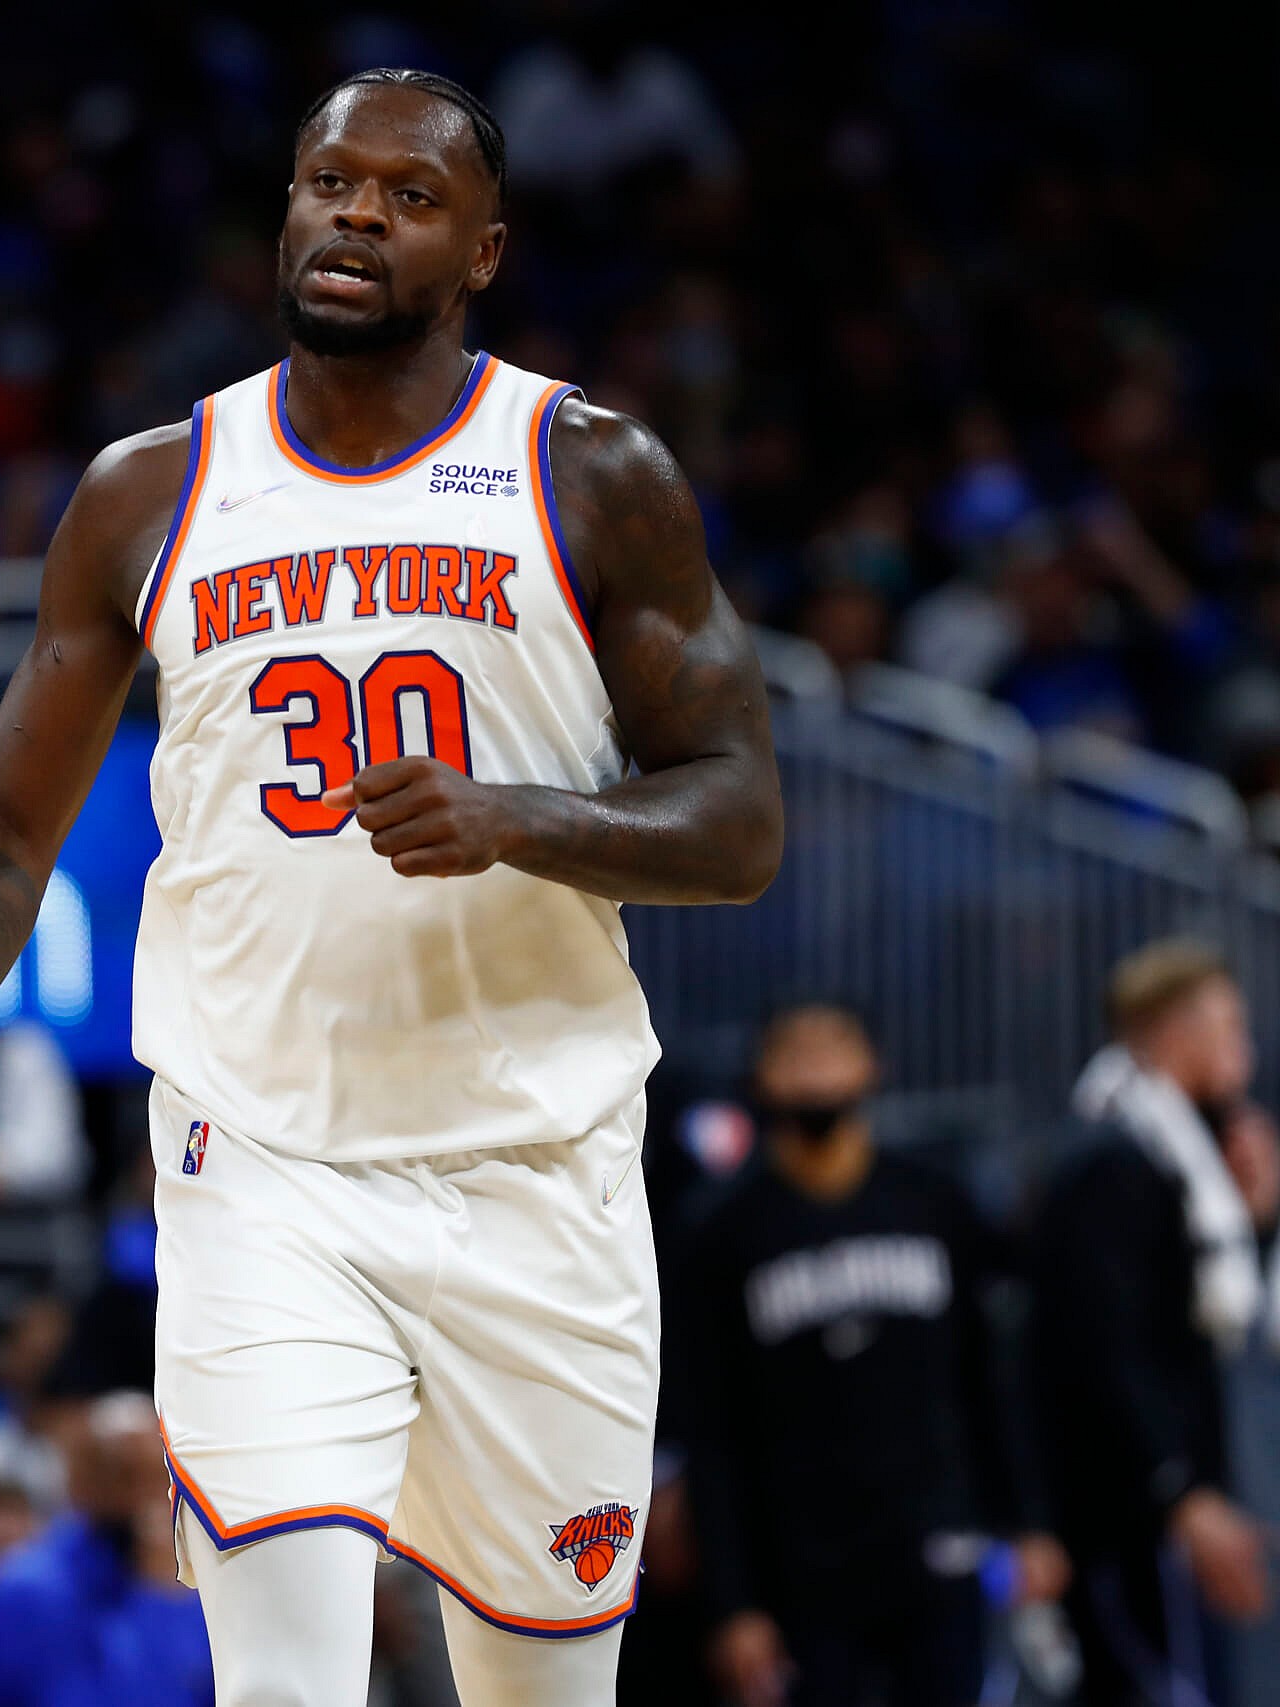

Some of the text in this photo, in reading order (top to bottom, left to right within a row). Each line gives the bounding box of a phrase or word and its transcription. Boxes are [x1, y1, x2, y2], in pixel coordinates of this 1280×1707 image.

[428, 479, 498, 496] SPACE
[431, 463, 518, 482] SQUARE
[190, 541, 520, 658] NEW YORK
[249, 648, 474, 839] 30
[549, 1505, 634, 1553] KNICKS
